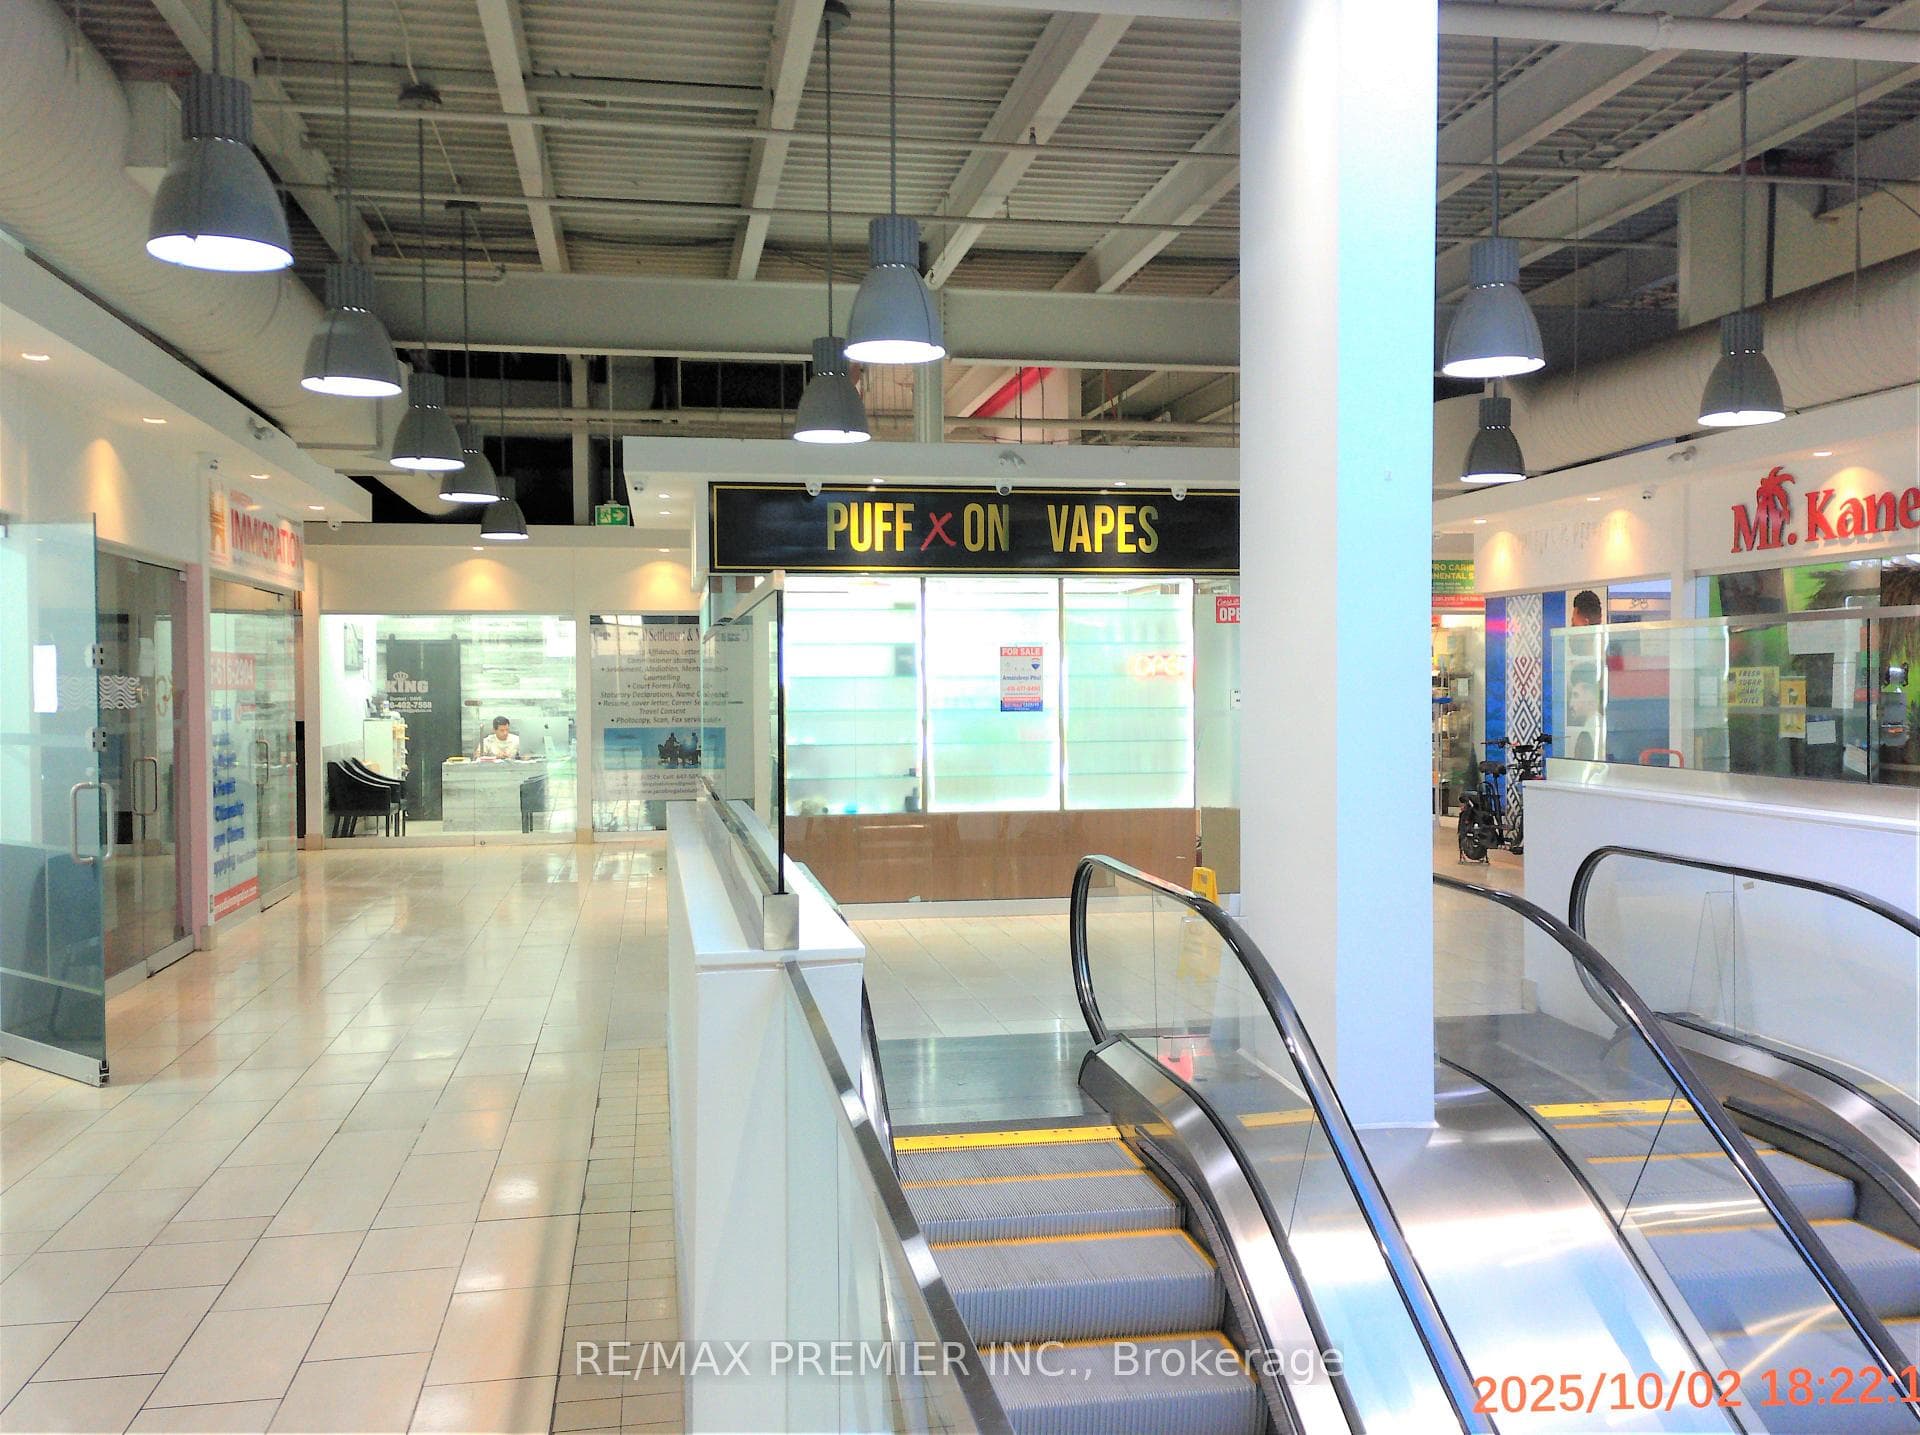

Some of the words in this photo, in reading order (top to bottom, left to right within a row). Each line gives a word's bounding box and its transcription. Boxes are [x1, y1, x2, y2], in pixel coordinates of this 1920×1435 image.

[827, 502, 914, 552] PUFF
[963, 502, 1010, 552] ON
[1047, 504, 1159, 554] VAPES
[1731, 502, 1798, 553] Mr.
[230, 508, 304, 570] IMMIGRATION
[648, 627, 686, 642] Settlement
[687, 629, 693, 642] &
[1002, 648, 1018, 656] FOR
[1020, 648, 1040, 656] SALE
[643, 674, 681, 682] Counselling
[385, 680, 429, 693] KING
[1740, 696, 1760, 704] JUICE
